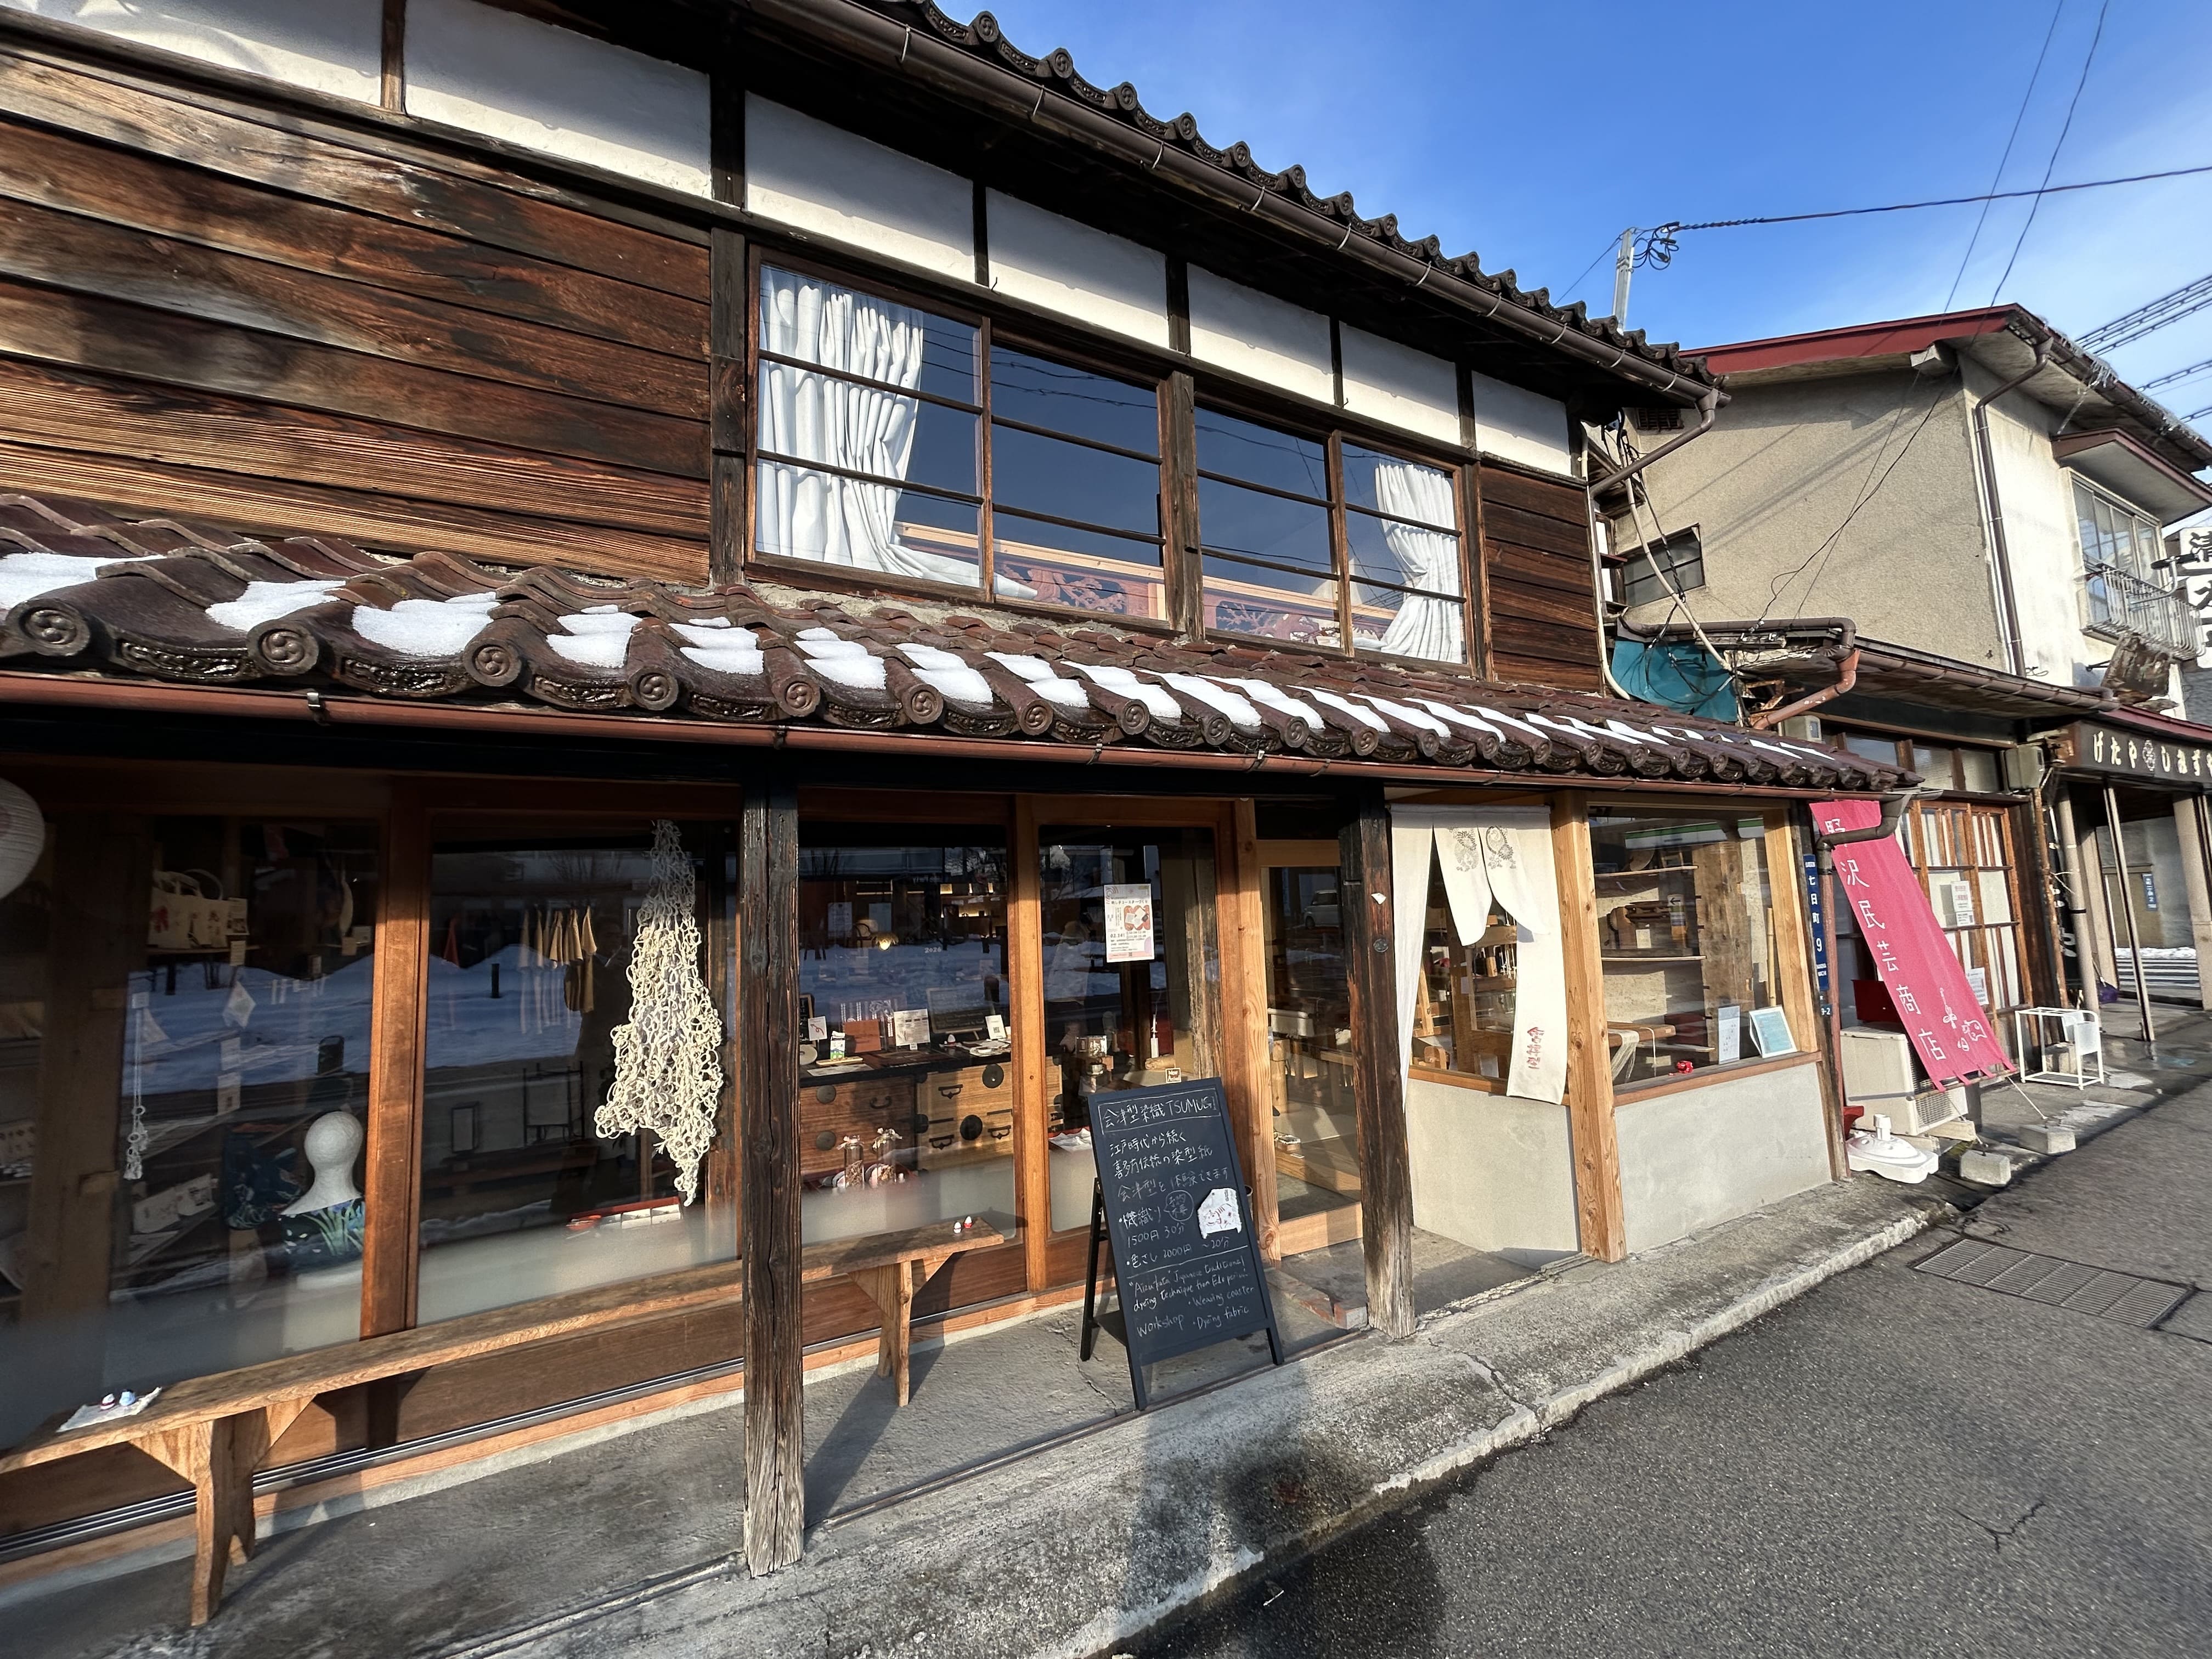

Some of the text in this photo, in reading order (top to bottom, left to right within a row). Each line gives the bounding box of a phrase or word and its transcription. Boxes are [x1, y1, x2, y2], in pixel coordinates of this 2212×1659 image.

[2093, 730, 2137, 769] げたや
[1808, 875, 1820, 924] 七日町
[1815, 938, 1822, 952] 9
[1102, 1096, 1217, 1128] 会津型染織 TSUMUGI
[1109, 1129, 1187, 1157] 江戸時代から続く
[1127, 1222, 1186, 1248] 1500円 30分
[1163, 1244, 1192, 1259] 2000円
[1133, 1297, 1157, 1312] dyeing
[1160, 1285, 1194, 1301] technique
[1227, 1285, 1254, 1299] coaster
[1197, 1314, 1222, 1330] Dyeing
[1224, 1305, 1250, 1319] fabric
